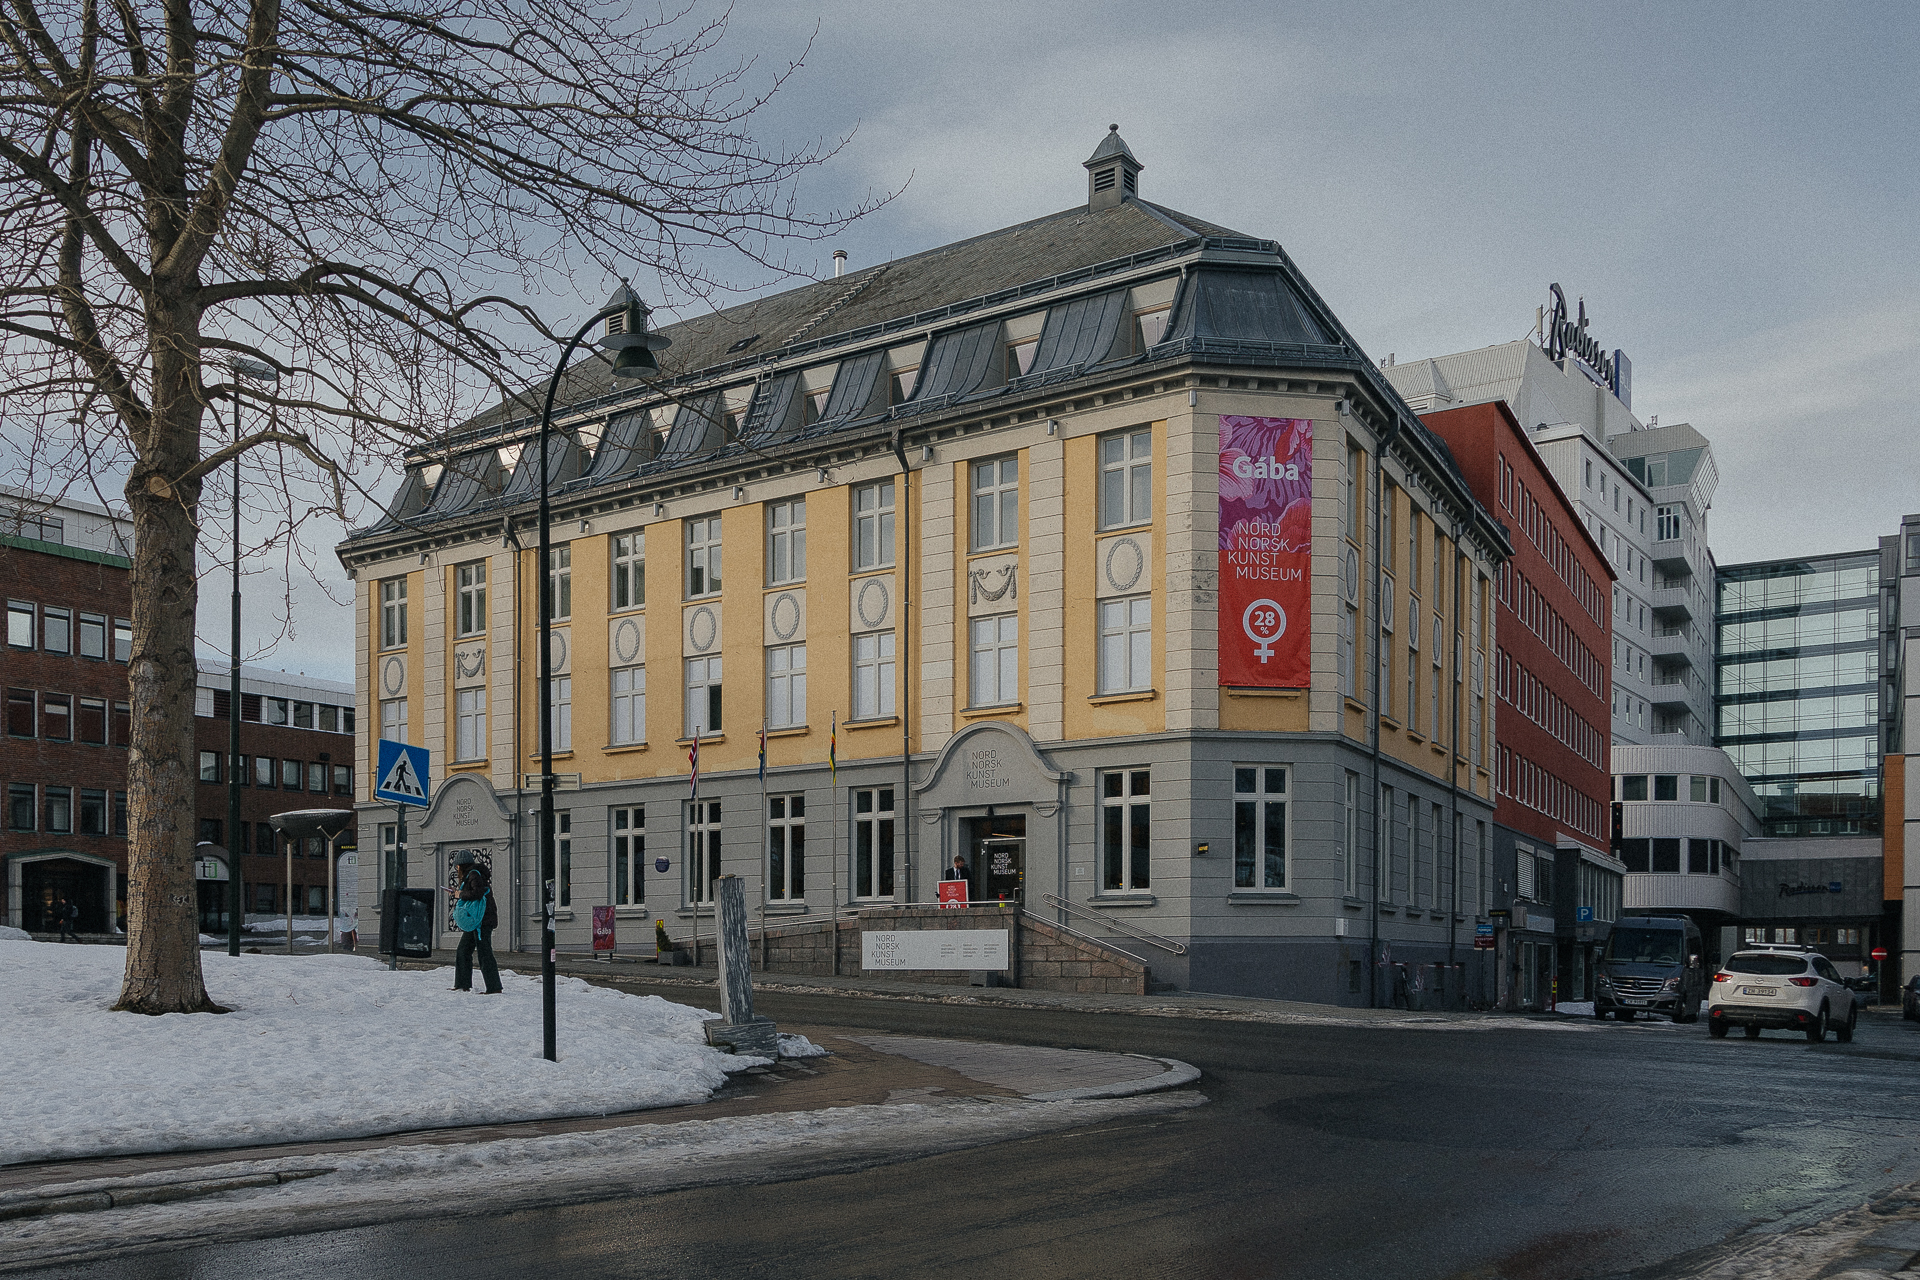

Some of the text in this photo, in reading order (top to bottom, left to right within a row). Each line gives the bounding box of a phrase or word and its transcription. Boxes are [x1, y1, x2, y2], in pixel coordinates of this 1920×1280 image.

[1232, 455, 1299, 481] Gába
[1238, 522, 1281, 536] NORD
[1238, 536, 1290, 551] NORSK
[1228, 551, 1280, 566] KUNST
[1236, 566, 1302, 582] MUSEUM
[1254, 610, 1276, 627] 28
[1260, 626, 1270, 635] %
[971, 749, 997, 760] NORD
[971, 759, 1003, 770] NORSK
[966, 769, 996, 780] KUNST
[970, 778, 1010, 789] MUSEUM
[456, 797, 472, 806] NORD
[456, 805, 475, 813] NORSK
[453, 812, 471, 820] KUNST
[455, 818, 479, 827] MUSEUM
[1580, 908, 1590, 920] P
[596, 927, 612, 935] Gába
[875, 934, 896, 943] NORD
[875, 942, 900, 951] NORSK
[871, 950, 895, 958] KUNST
[874, 958, 906, 967] MUSEUM
